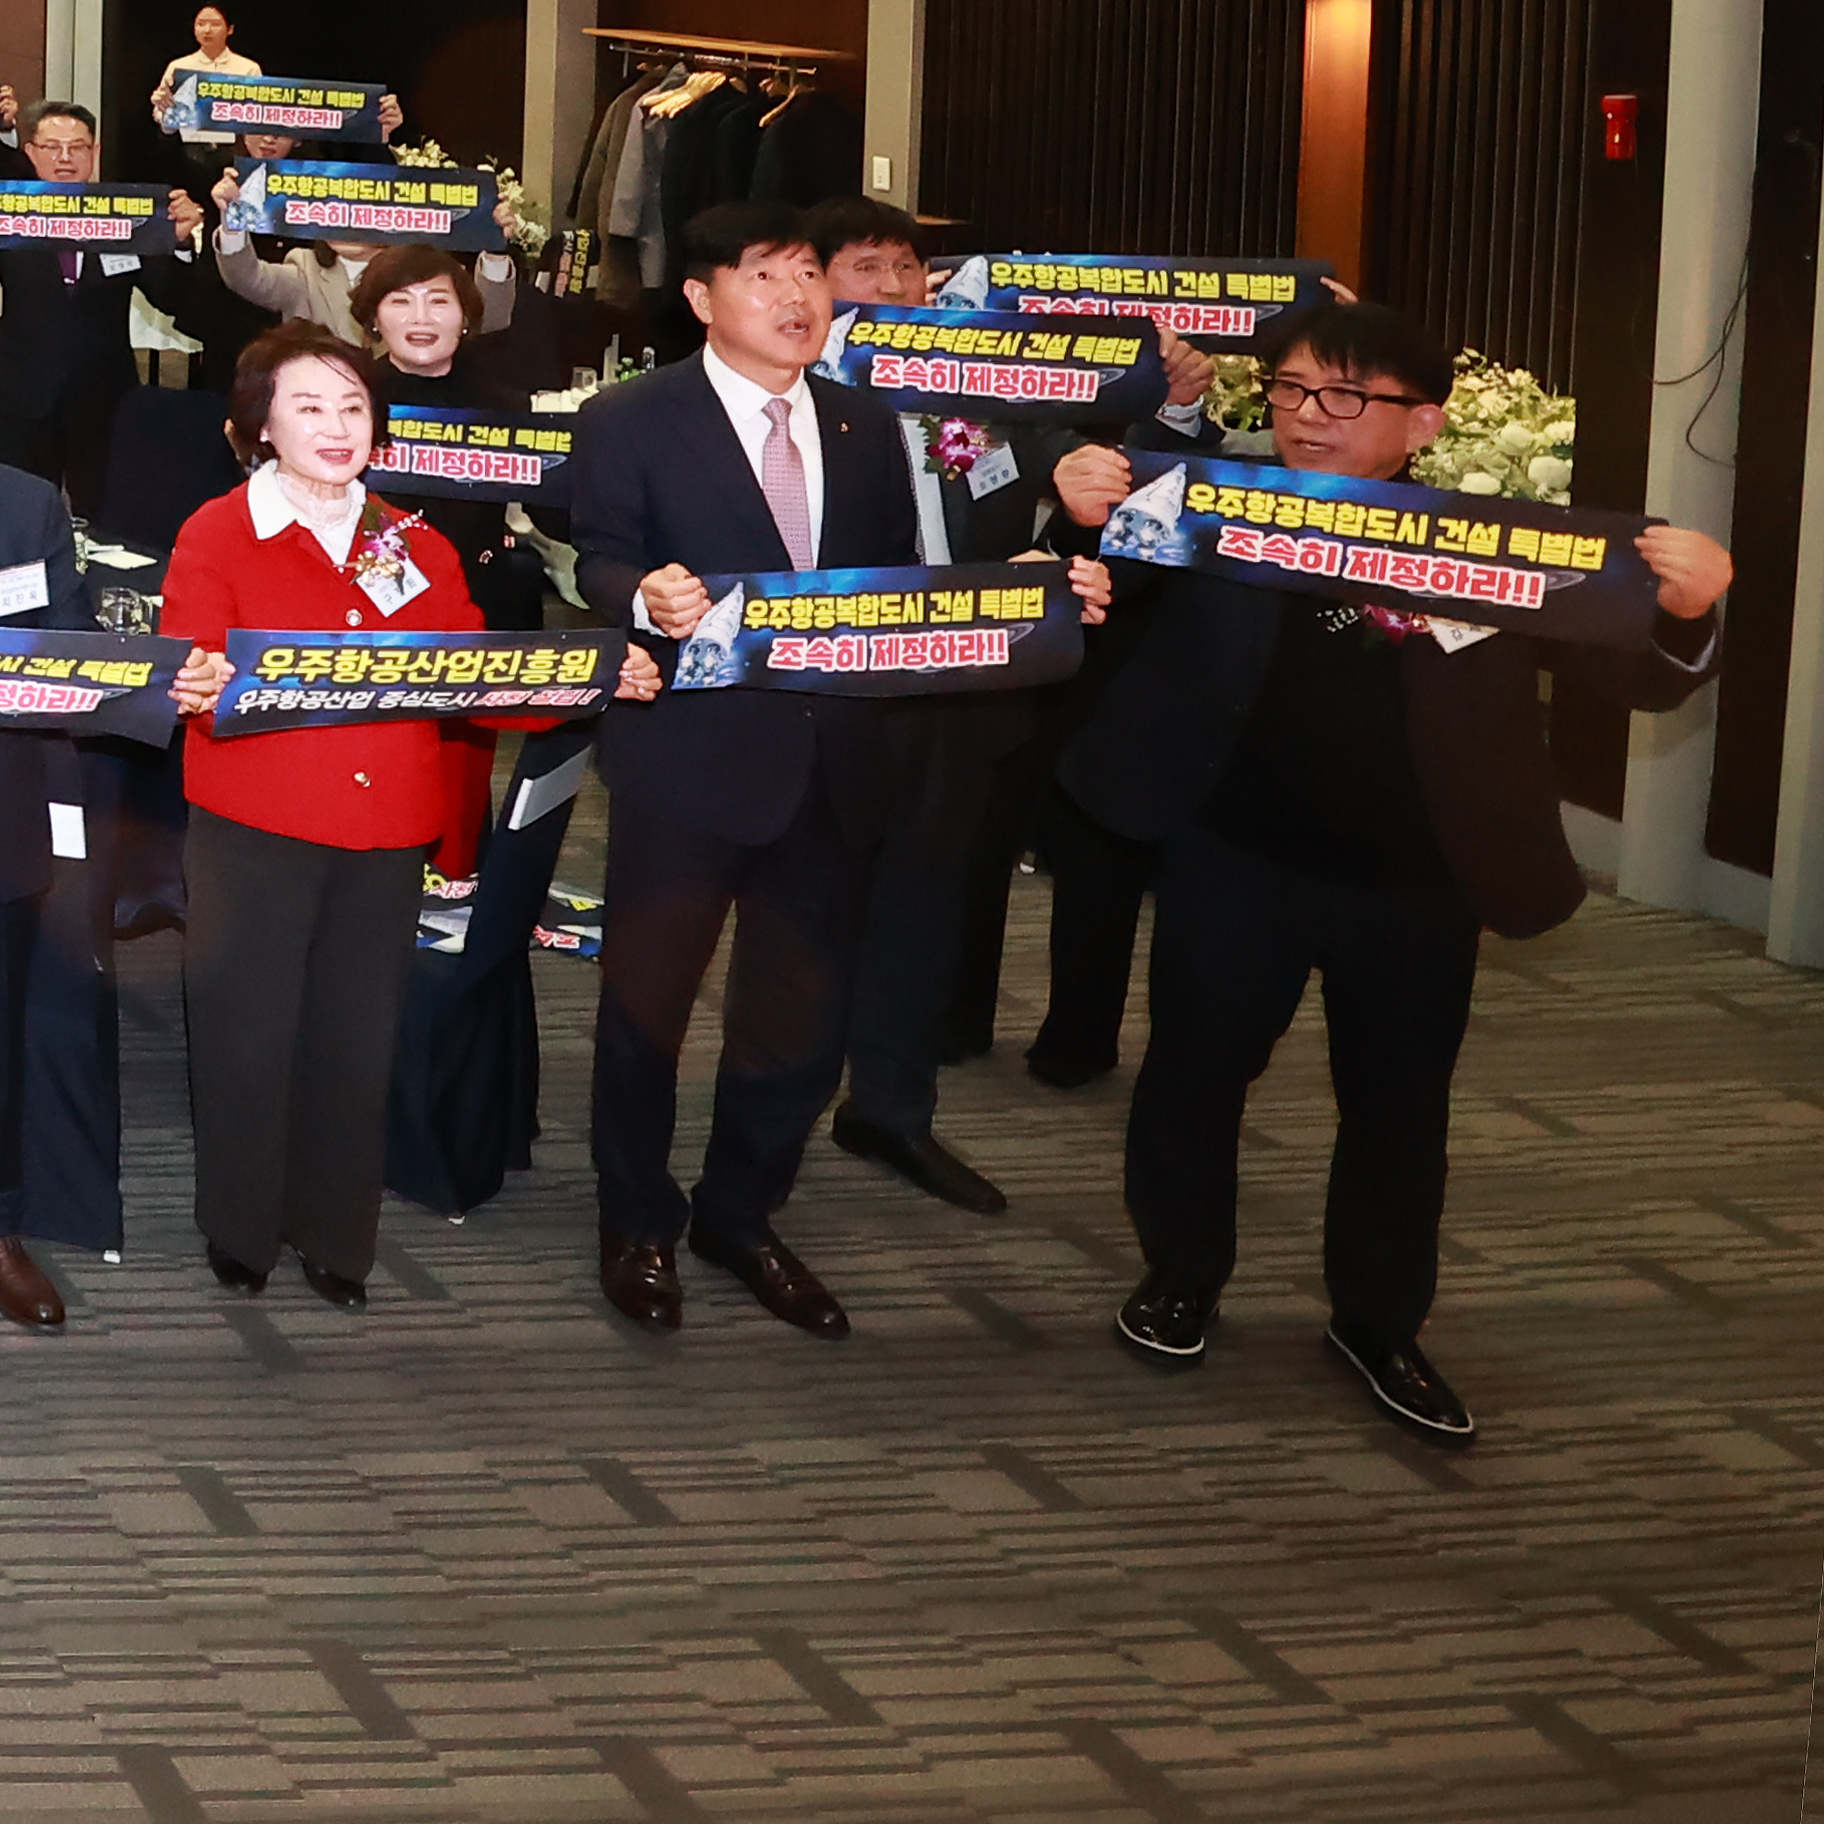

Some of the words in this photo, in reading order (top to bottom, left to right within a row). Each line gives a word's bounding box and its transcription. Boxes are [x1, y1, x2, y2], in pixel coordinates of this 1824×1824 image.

[83, 196, 109, 214] 건설
[393, 181, 426, 203] 건설
[46, 216, 131, 239] 제정하라!!
[285, 200, 349, 227] 조속히
[349, 204, 451, 233] 제정하라!!
[991, 262, 1168, 294] 우주항공복합도시
[1173, 271, 1219, 298] 건설
[1226, 273, 1295, 301] 특별법
[847, 321, 1022, 356] 우주항공복합도시
[1022, 333, 1071, 360] 건설
[1072, 335, 1140, 364] 특별법
[870, 354, 960, 393] 조속히
[960, 361, 1099, 401] 제정하라!!
[467, 425, 509, 446] 건설
[411, 444, 541, 485] 제정하라!!
[1186, 483, 1428, 545] 우주항공복합도시
[1434, 517, 1500, 556] 건설
[1508, 527, 1606, 569] 특별법
[1216, 525, 1343, 576] 조속히
[1342, 545, 1546, 608] 제정하라!!
[744, 592, 923, 629] 우주항공복합도시
[929, 590, 973, 622] 건설
[979, 587, 1043, 619] 특별법
[261, 649, 597, 683] 우주항공산업진흥원
[766, 634, 867, 671] 조속히
[868, 628, 1008, 670] 제정하라!!
[26, 657, 76, 677] 건설
[76, 660, 152, 686] 특별법
[234, 689, 375, 714] 우주항공산업
[377, 690, 475, 709] 중심도시
